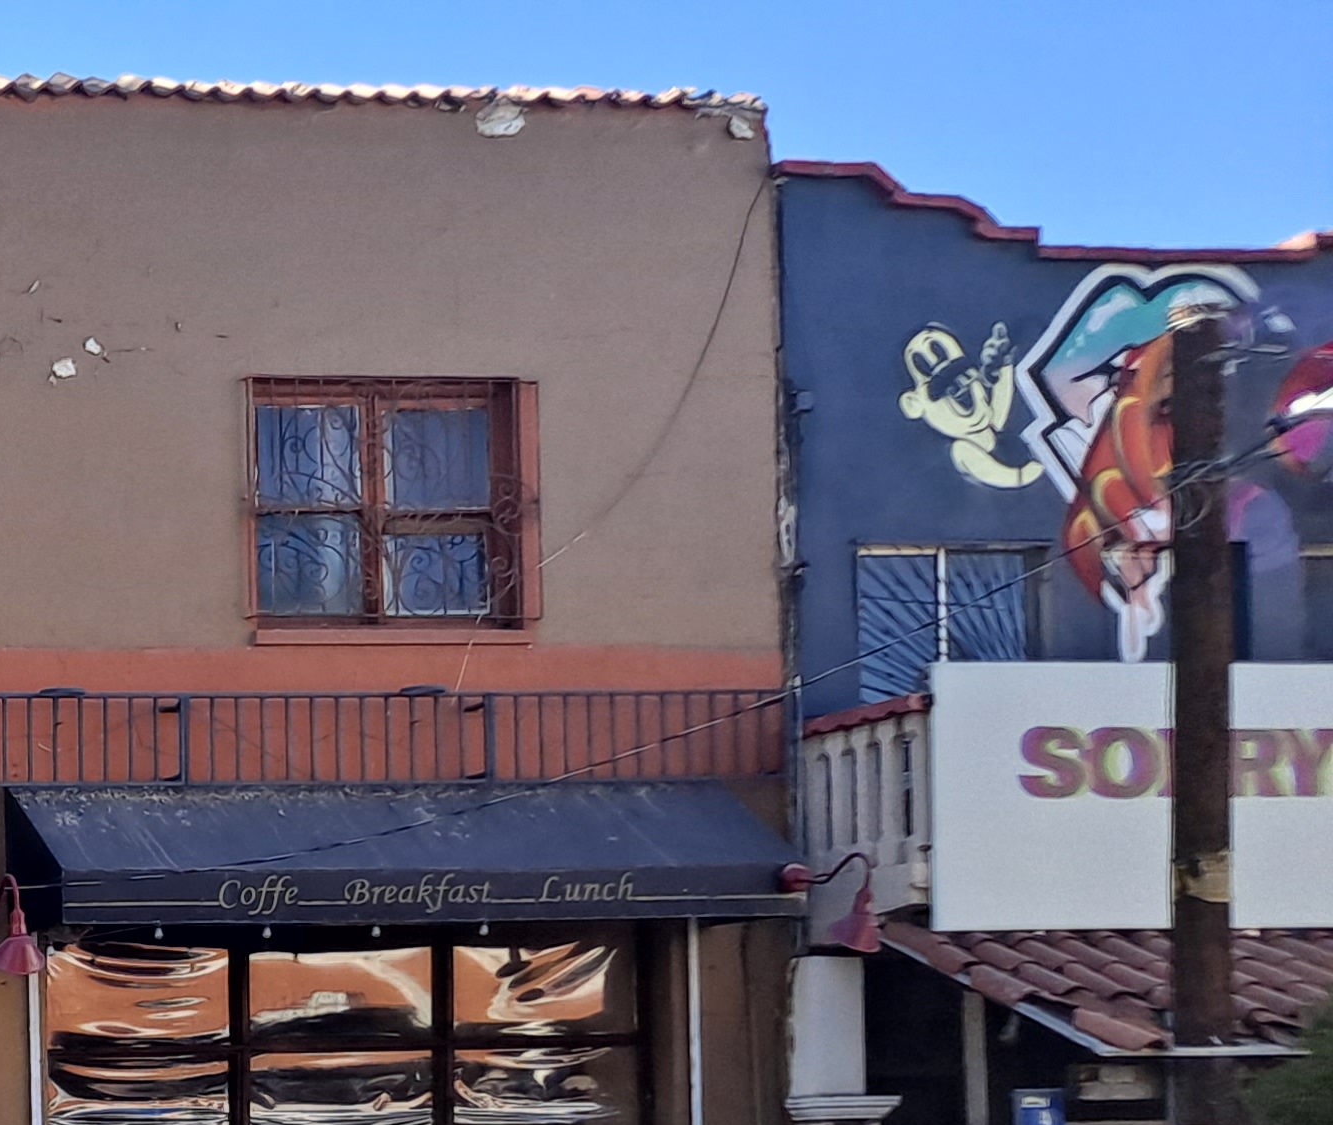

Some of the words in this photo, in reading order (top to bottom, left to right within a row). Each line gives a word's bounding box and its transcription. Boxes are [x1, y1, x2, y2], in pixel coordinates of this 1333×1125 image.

[218, 875, 299, 916] Coffe
[343, 873, 493, 914] Breakfast
[539, 872, 635, 902] Lunch
